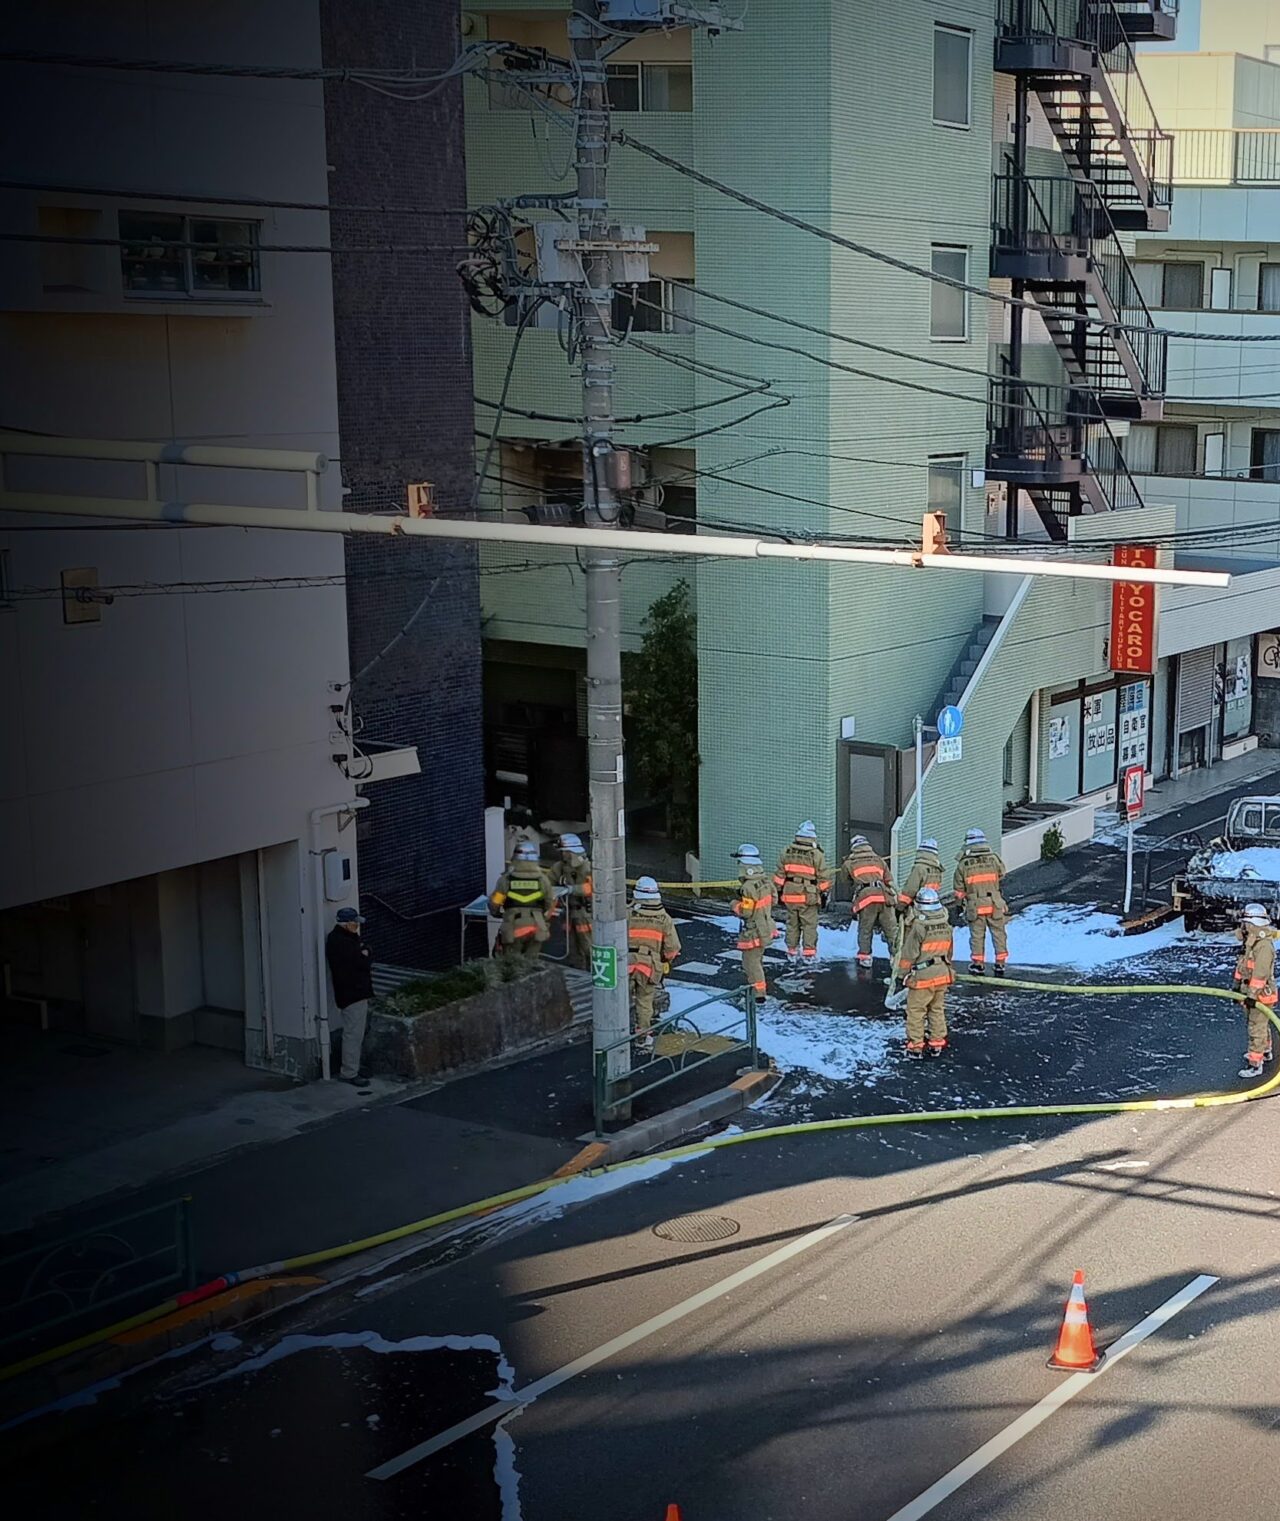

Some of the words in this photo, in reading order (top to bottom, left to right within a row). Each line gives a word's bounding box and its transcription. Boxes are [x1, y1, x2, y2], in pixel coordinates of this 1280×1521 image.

[1126, 549, 1147, 669] TOYOCAROL
[1088, 728, 1115, 751] 放出品
